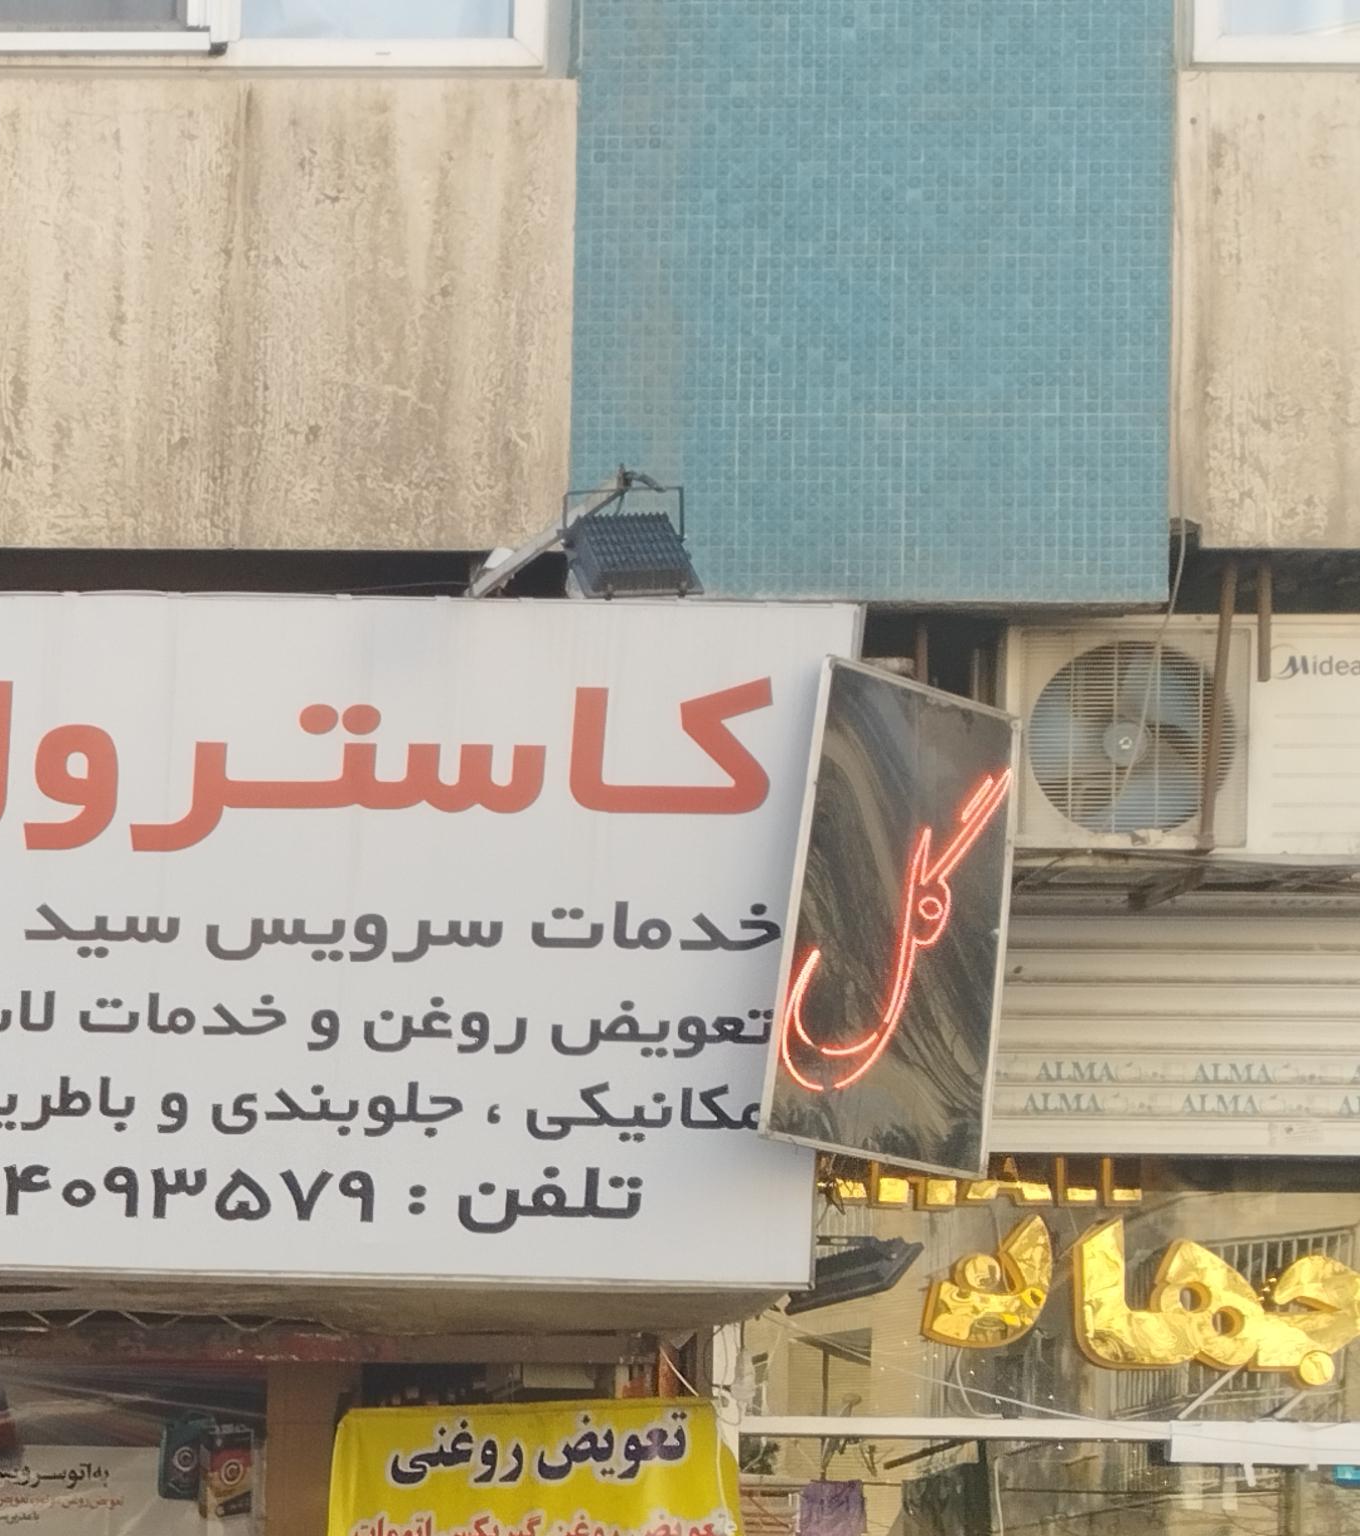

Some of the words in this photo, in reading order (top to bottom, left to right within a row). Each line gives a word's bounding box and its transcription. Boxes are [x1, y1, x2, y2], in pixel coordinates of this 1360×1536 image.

[1278, 655, 1360, 680] Midea
[25, 904, 179, 955] سید
[206, 914, 503, 963] سرویس
[531, 900, 782, 952] خدمات
[79, 992, 286, 1036] خدمات
[307, 1009, 340, 1051] و
[363, 997, 527, 1054] روغن
[551, 1000, 774, 1059] تعویض
[1037, 1061, 1117, 1082] ALMA
[1194, 1063, 1274, 1084] ALMA
[157, 1092, 188, 1134] و
[211, 1084, 463, 1138] جلوبندی
[526, 1083, 760, 1142] مکانیکی
[1023, 1092, 1102, 1113] ALMA
[1180, 1094, 1260, 1115] ALMA
[458, 1167, 643, 1234] تلفن
[390, 1419, 524, 1485] روغنی
[537, 1410, 687, 1480] تعویض
